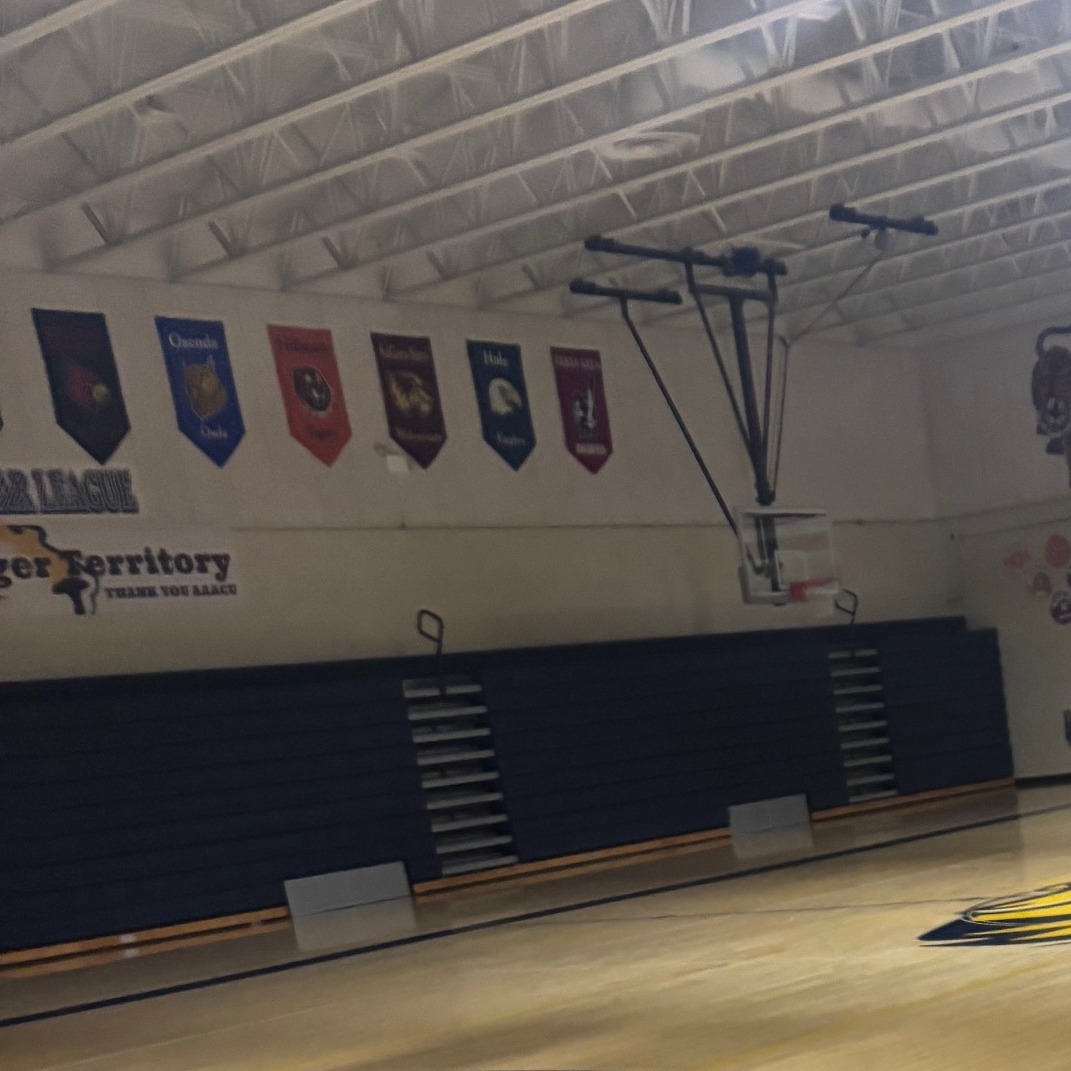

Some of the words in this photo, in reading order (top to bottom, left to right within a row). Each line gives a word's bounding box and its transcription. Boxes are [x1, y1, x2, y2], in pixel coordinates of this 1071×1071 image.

[31, 468, 139, 514] LEAGUE
[61, 547, 231, 582] Territory
[161, 585, 190, 598] YOU
